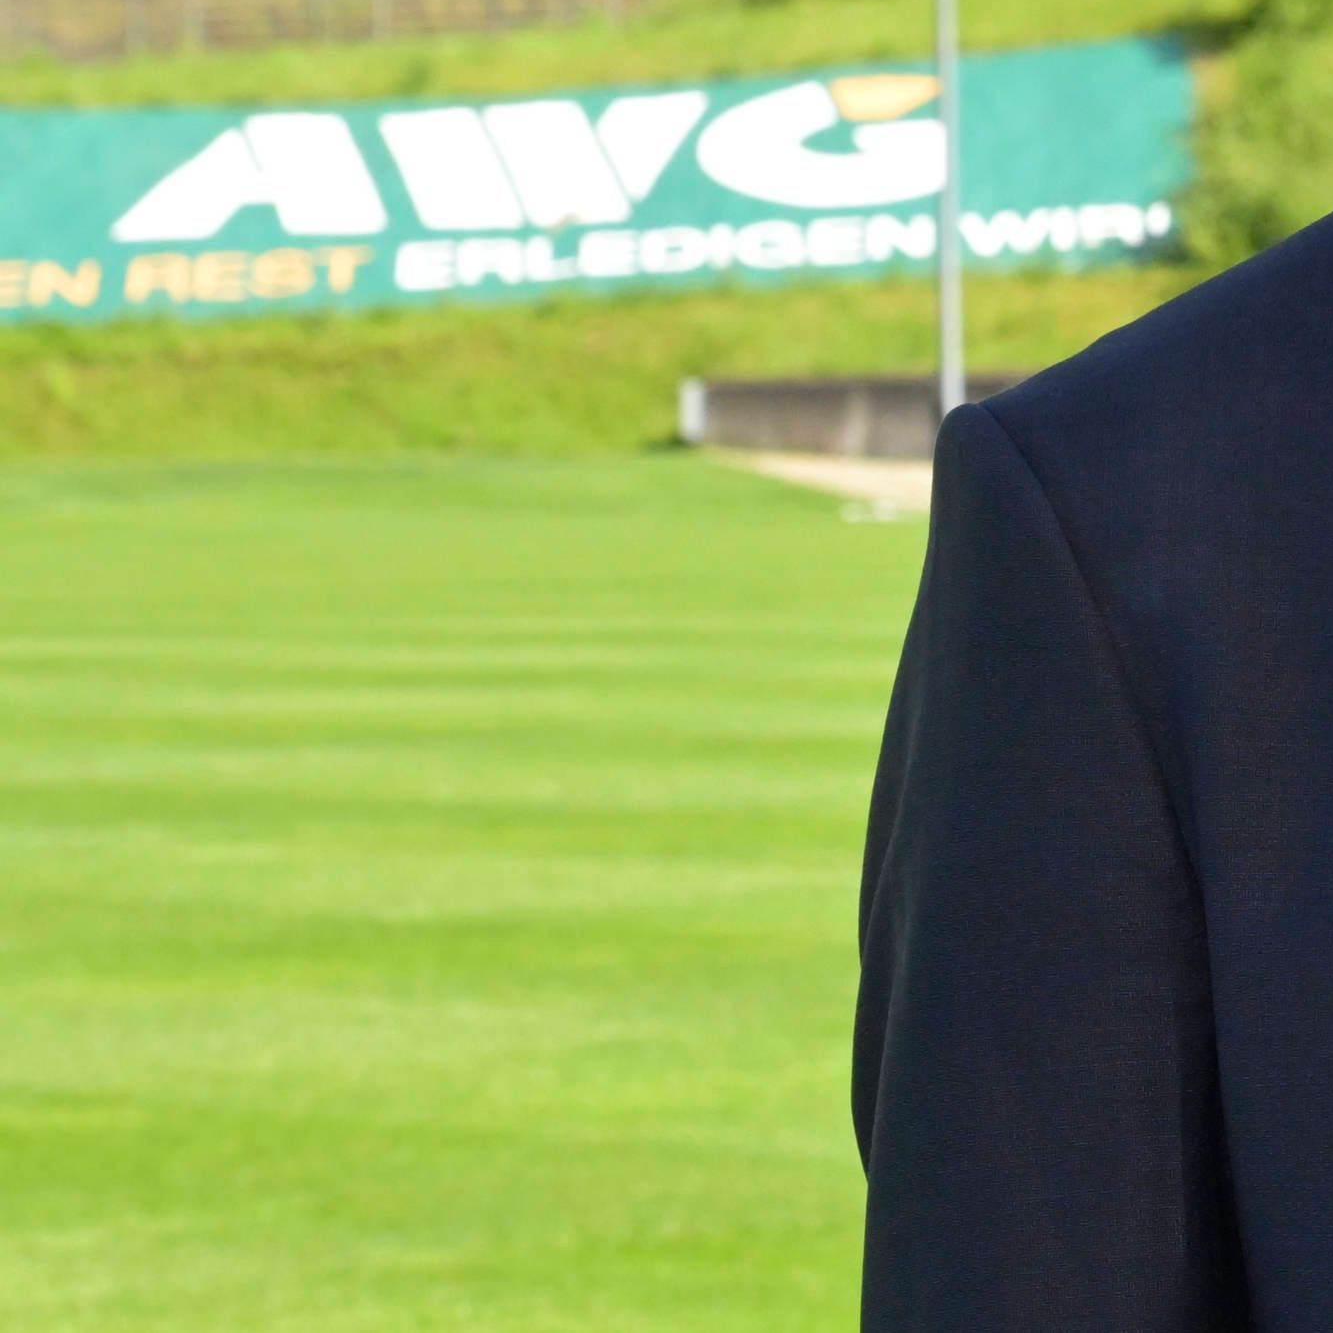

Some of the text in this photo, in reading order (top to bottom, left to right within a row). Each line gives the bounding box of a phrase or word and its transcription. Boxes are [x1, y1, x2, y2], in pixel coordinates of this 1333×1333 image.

[110, 74, 947, 241] AWG
[124, 245, 373, 303] REST
[394, 214, 936, 290] ERLEDIGEN
